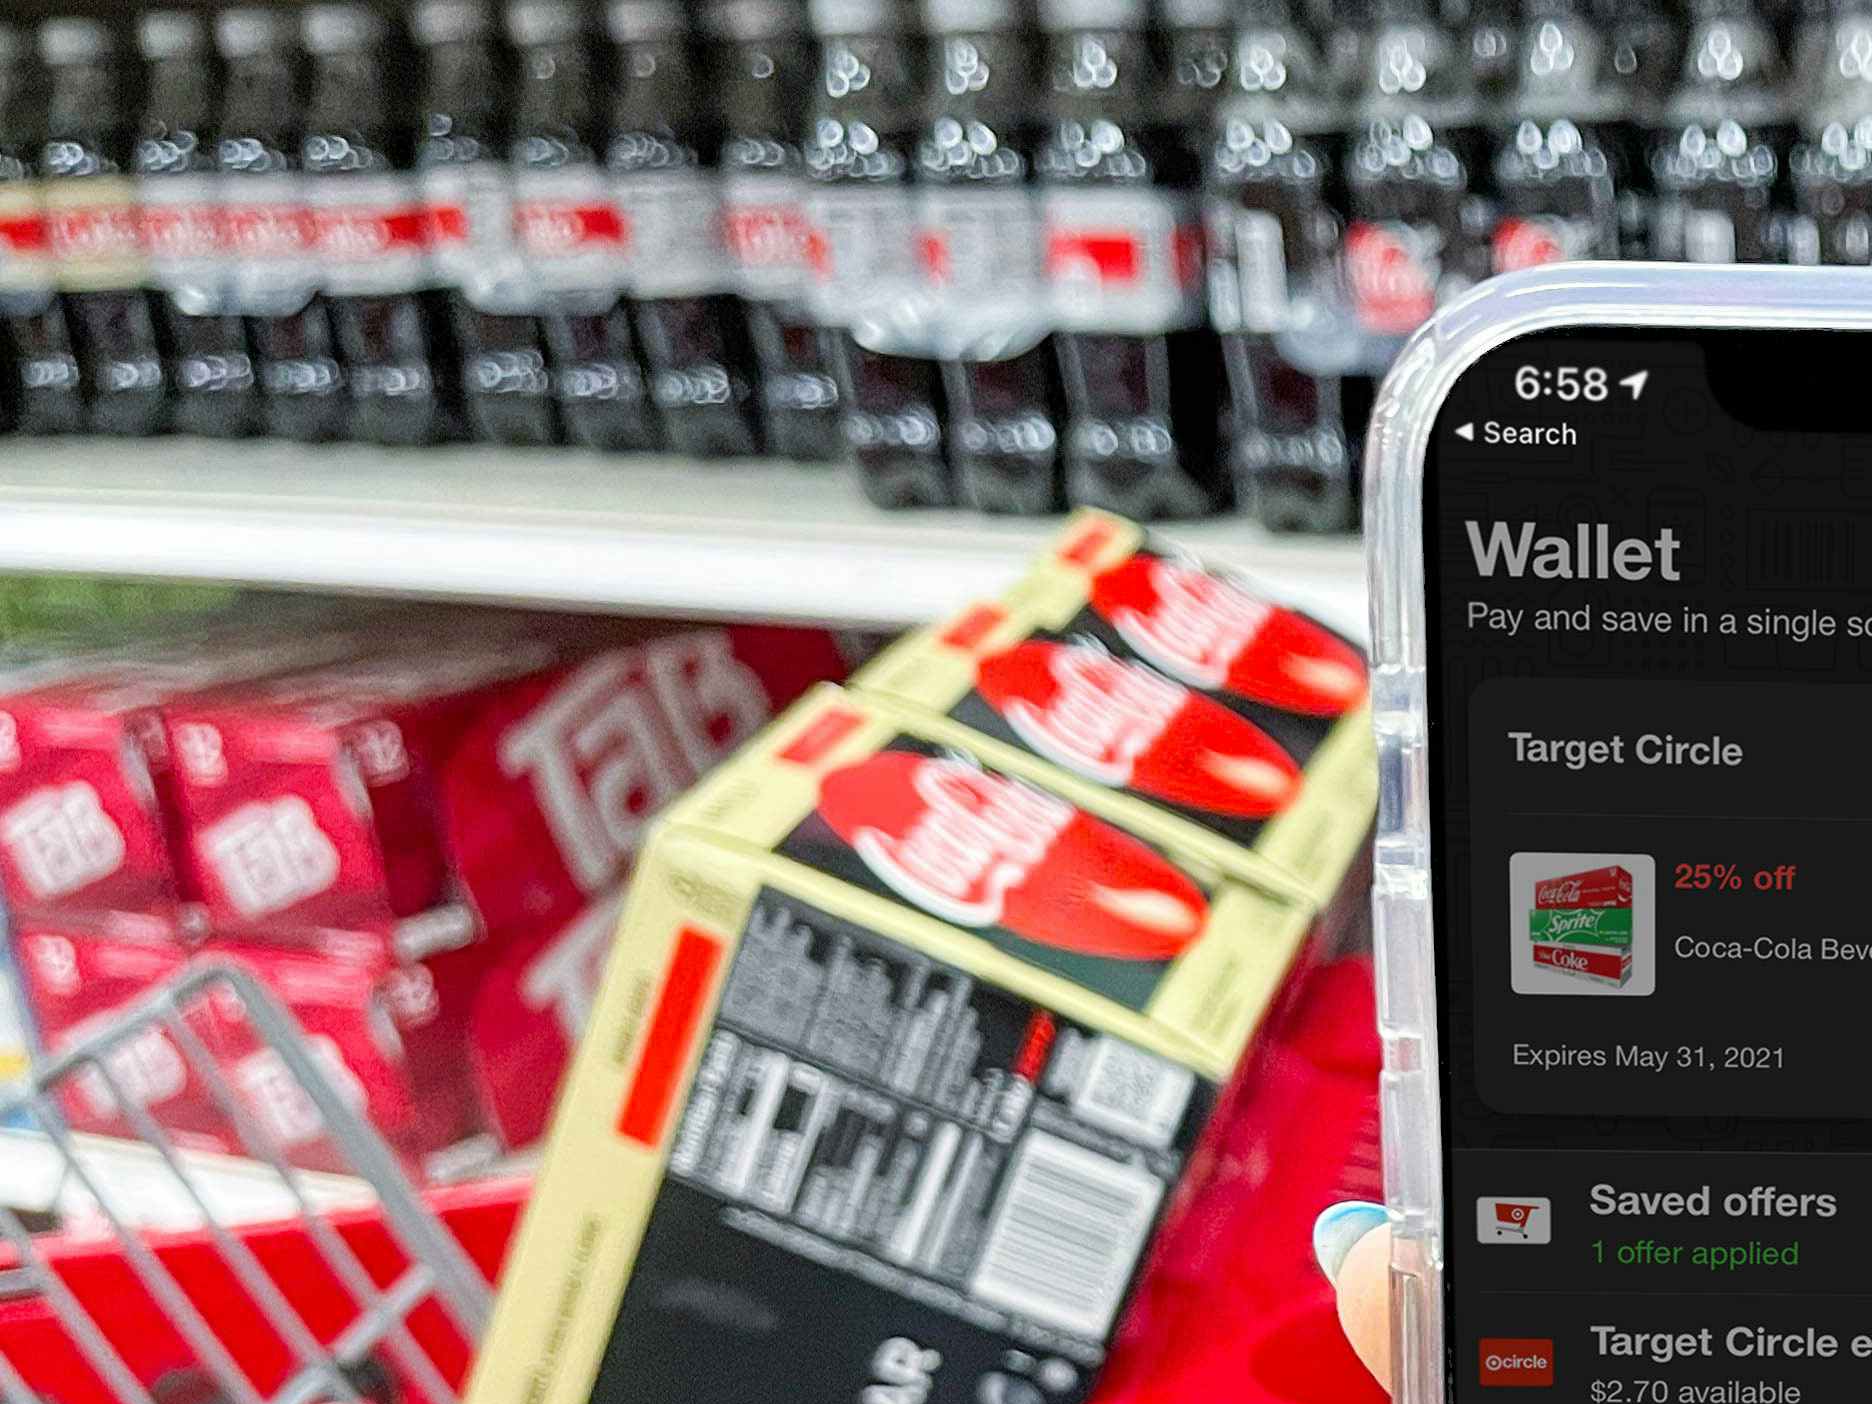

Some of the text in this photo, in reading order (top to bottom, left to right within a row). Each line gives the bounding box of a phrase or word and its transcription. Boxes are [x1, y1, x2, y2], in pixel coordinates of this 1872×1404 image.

[1515, 366, 1608, 401] 6:58
[1485, 421, 1576, 445] Search
[1465, 521, 1680, 581] Wallet
[1468, 602, 1523, 636] Pay
[1535, 604, 1589, 630] and
[1602, 611, 1672, 632] save
[1684, 607, 1707, 633] in
[1720, 614, 1737, 634] a
[1748, 608, 1836, 642] single
[1508, 732, 1743, 769] Target Circle
[1675, 864, 1796, 890] 25% off
[1551, 912, 1594, 933] Sprite
[1552, 948, 1588, 970] Coke
[1675, 936, 1812, 959] Coca-Cola
[1514, 1044, 1782, 1072] Expires May 31, 2021
[1590, 1184, 1836, 1217] Saved offers
[1592, 1240, 1798, 1270] 1 offer applied
[1590, 1326, 1712, 1362] Target
[1726, 1327, 1838, 1357] Circle
[1503, 1354, 1547, 1369] circle
[1591, 1380, 1800, 1404] $2.70 available
